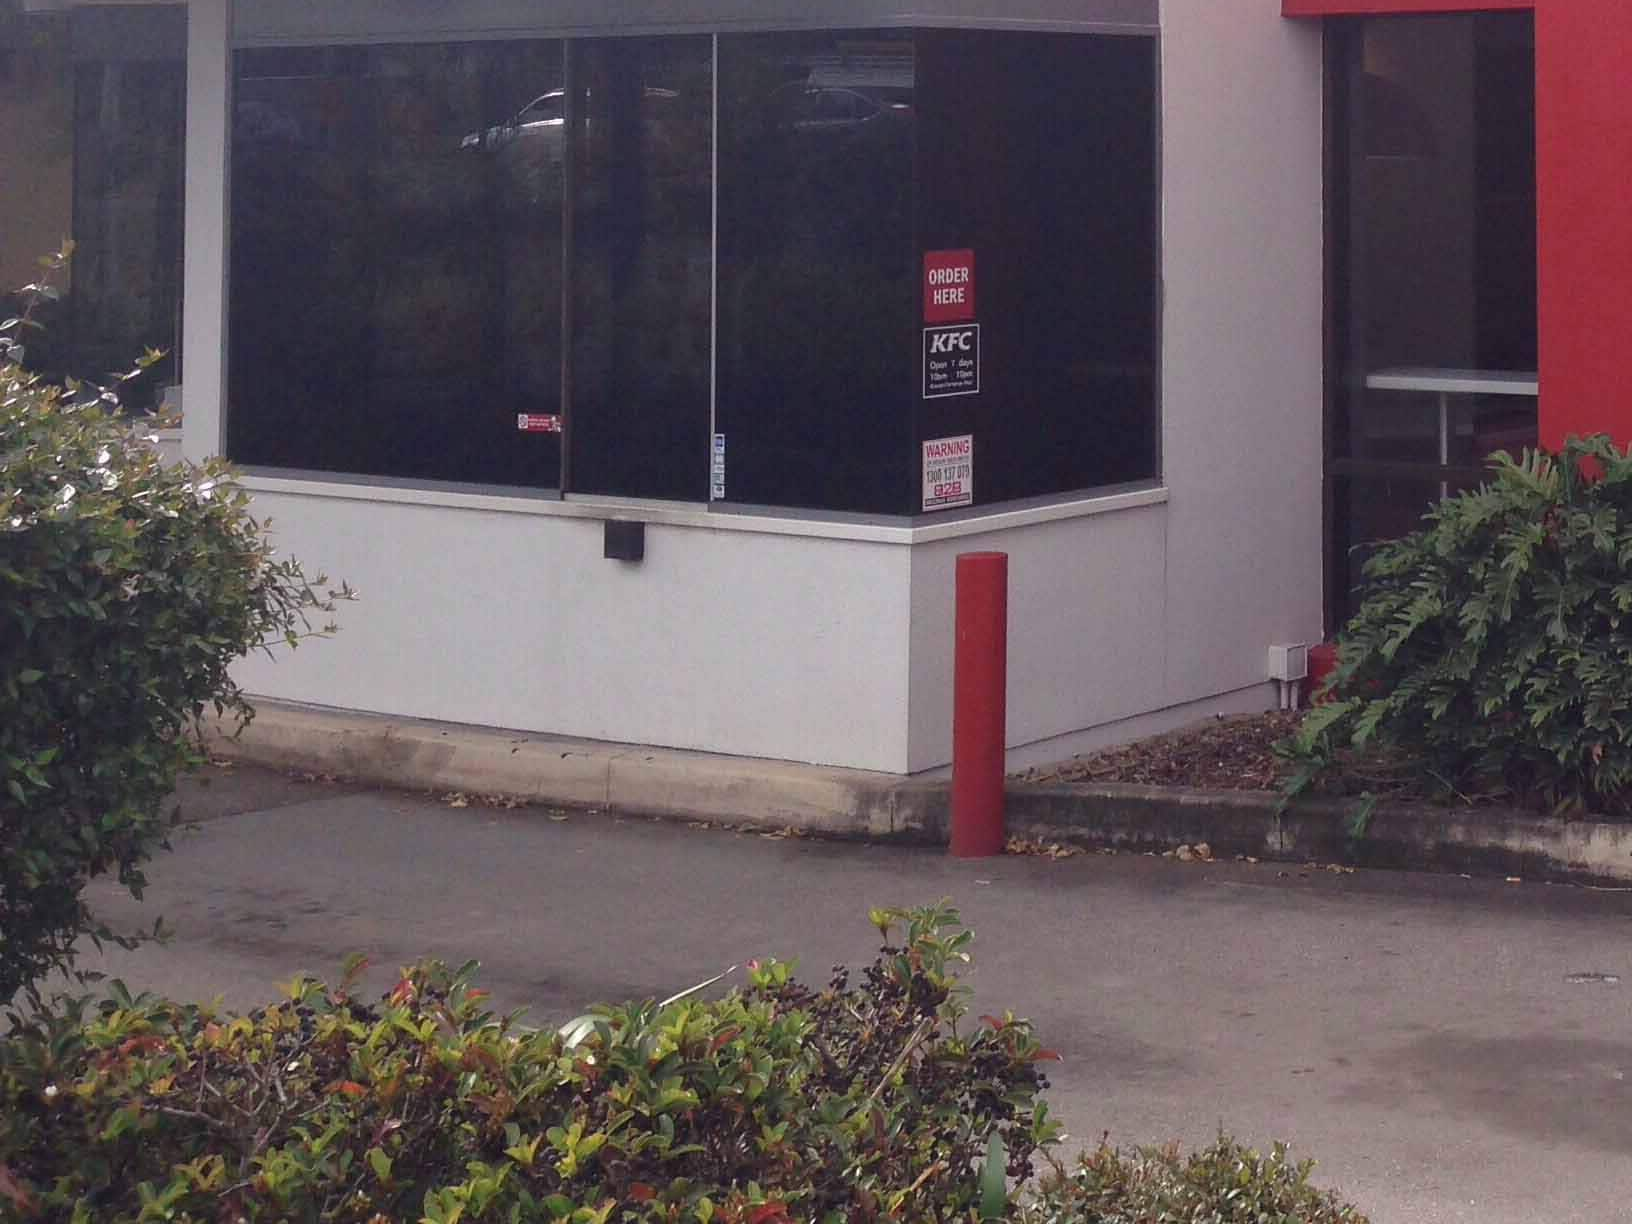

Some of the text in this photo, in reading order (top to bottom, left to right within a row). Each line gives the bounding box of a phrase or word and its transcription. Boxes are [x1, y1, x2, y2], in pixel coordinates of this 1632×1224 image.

[928, 267, 969, 286] ORDER
[934, 288, 966, 305] HERE
[929, 331, 973, 354] KFC
[930, 360, 948, 371] Open
[926, 439, 970, 458] WARNING
